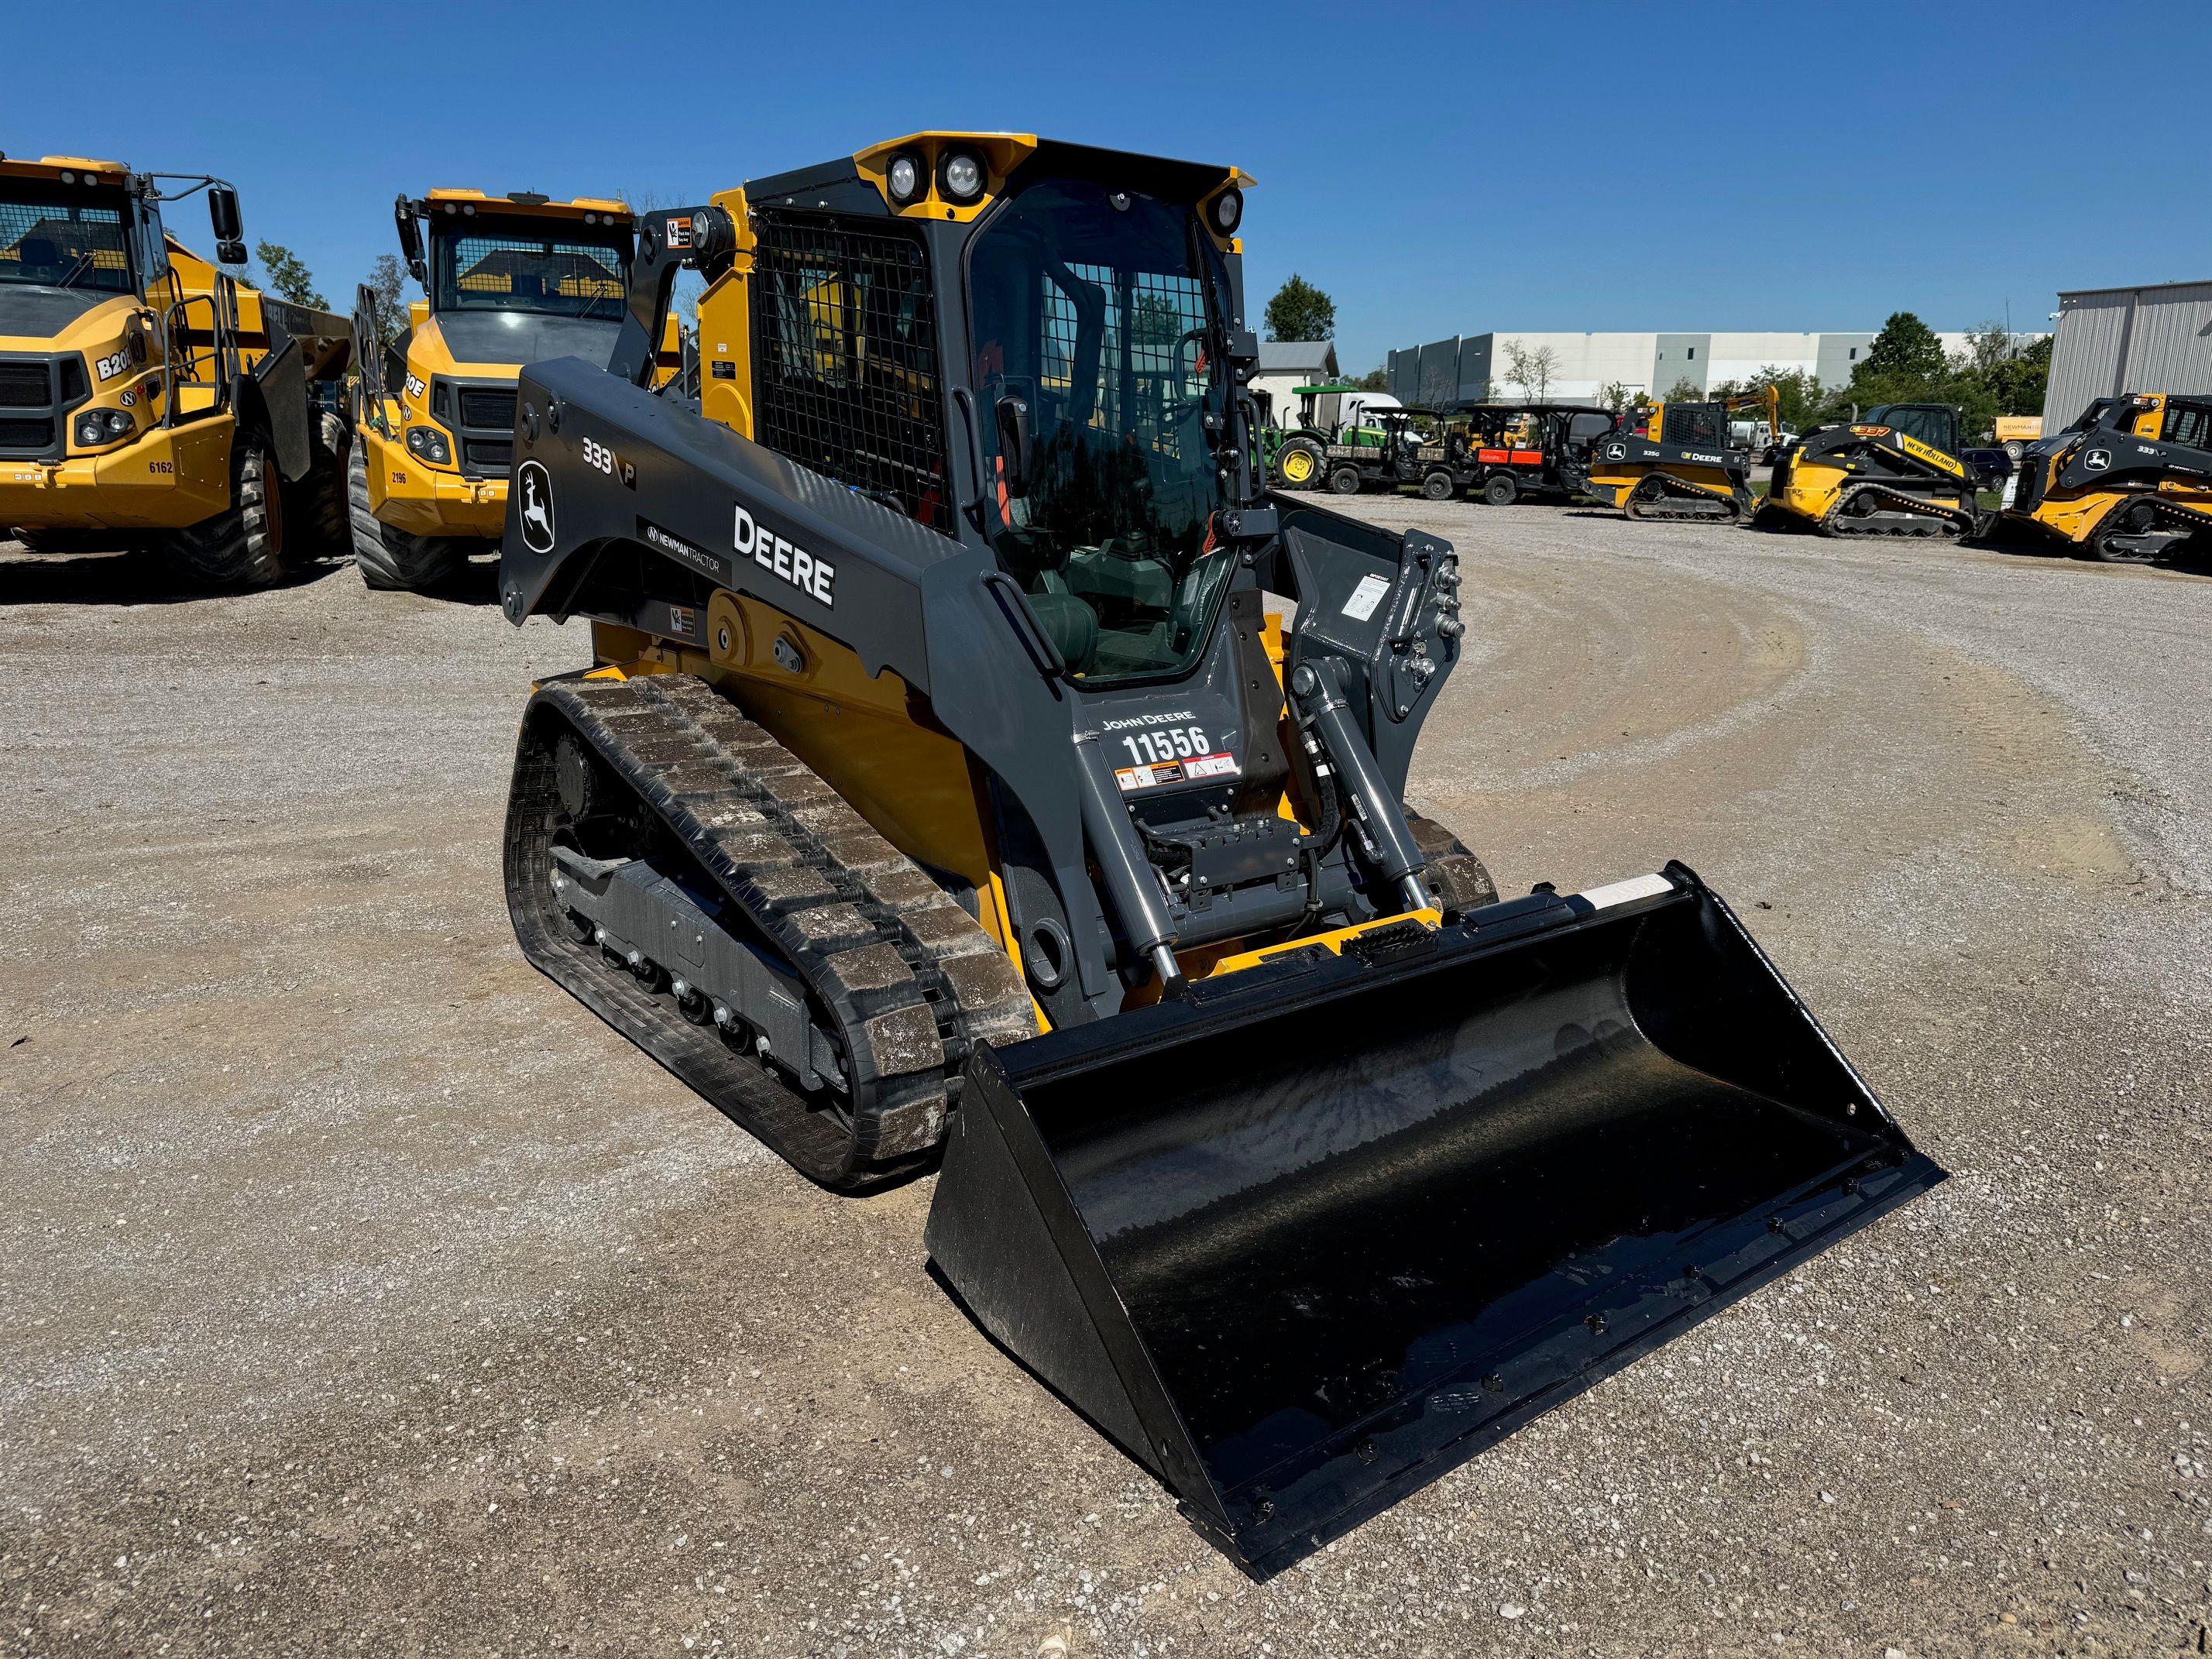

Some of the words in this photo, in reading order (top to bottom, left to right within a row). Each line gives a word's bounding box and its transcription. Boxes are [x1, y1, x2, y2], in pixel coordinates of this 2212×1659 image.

[582, 436, 612, 475] 333
[1692, 453, 1723, 463] DEERE
[1906, 441, 1923, 452] NEW
[1923, 449, 1954, 468] HOLLAND
[149, 462, 173, 473] 6162
[392, 472, 407, 484] 2196
[734, 505, 834, 606] DEERE
[1102, 717, 1145, 731] JOHN
[1141, 710, 1197, 725] DEERE
[1121, 726, 1210, 765] 11556
